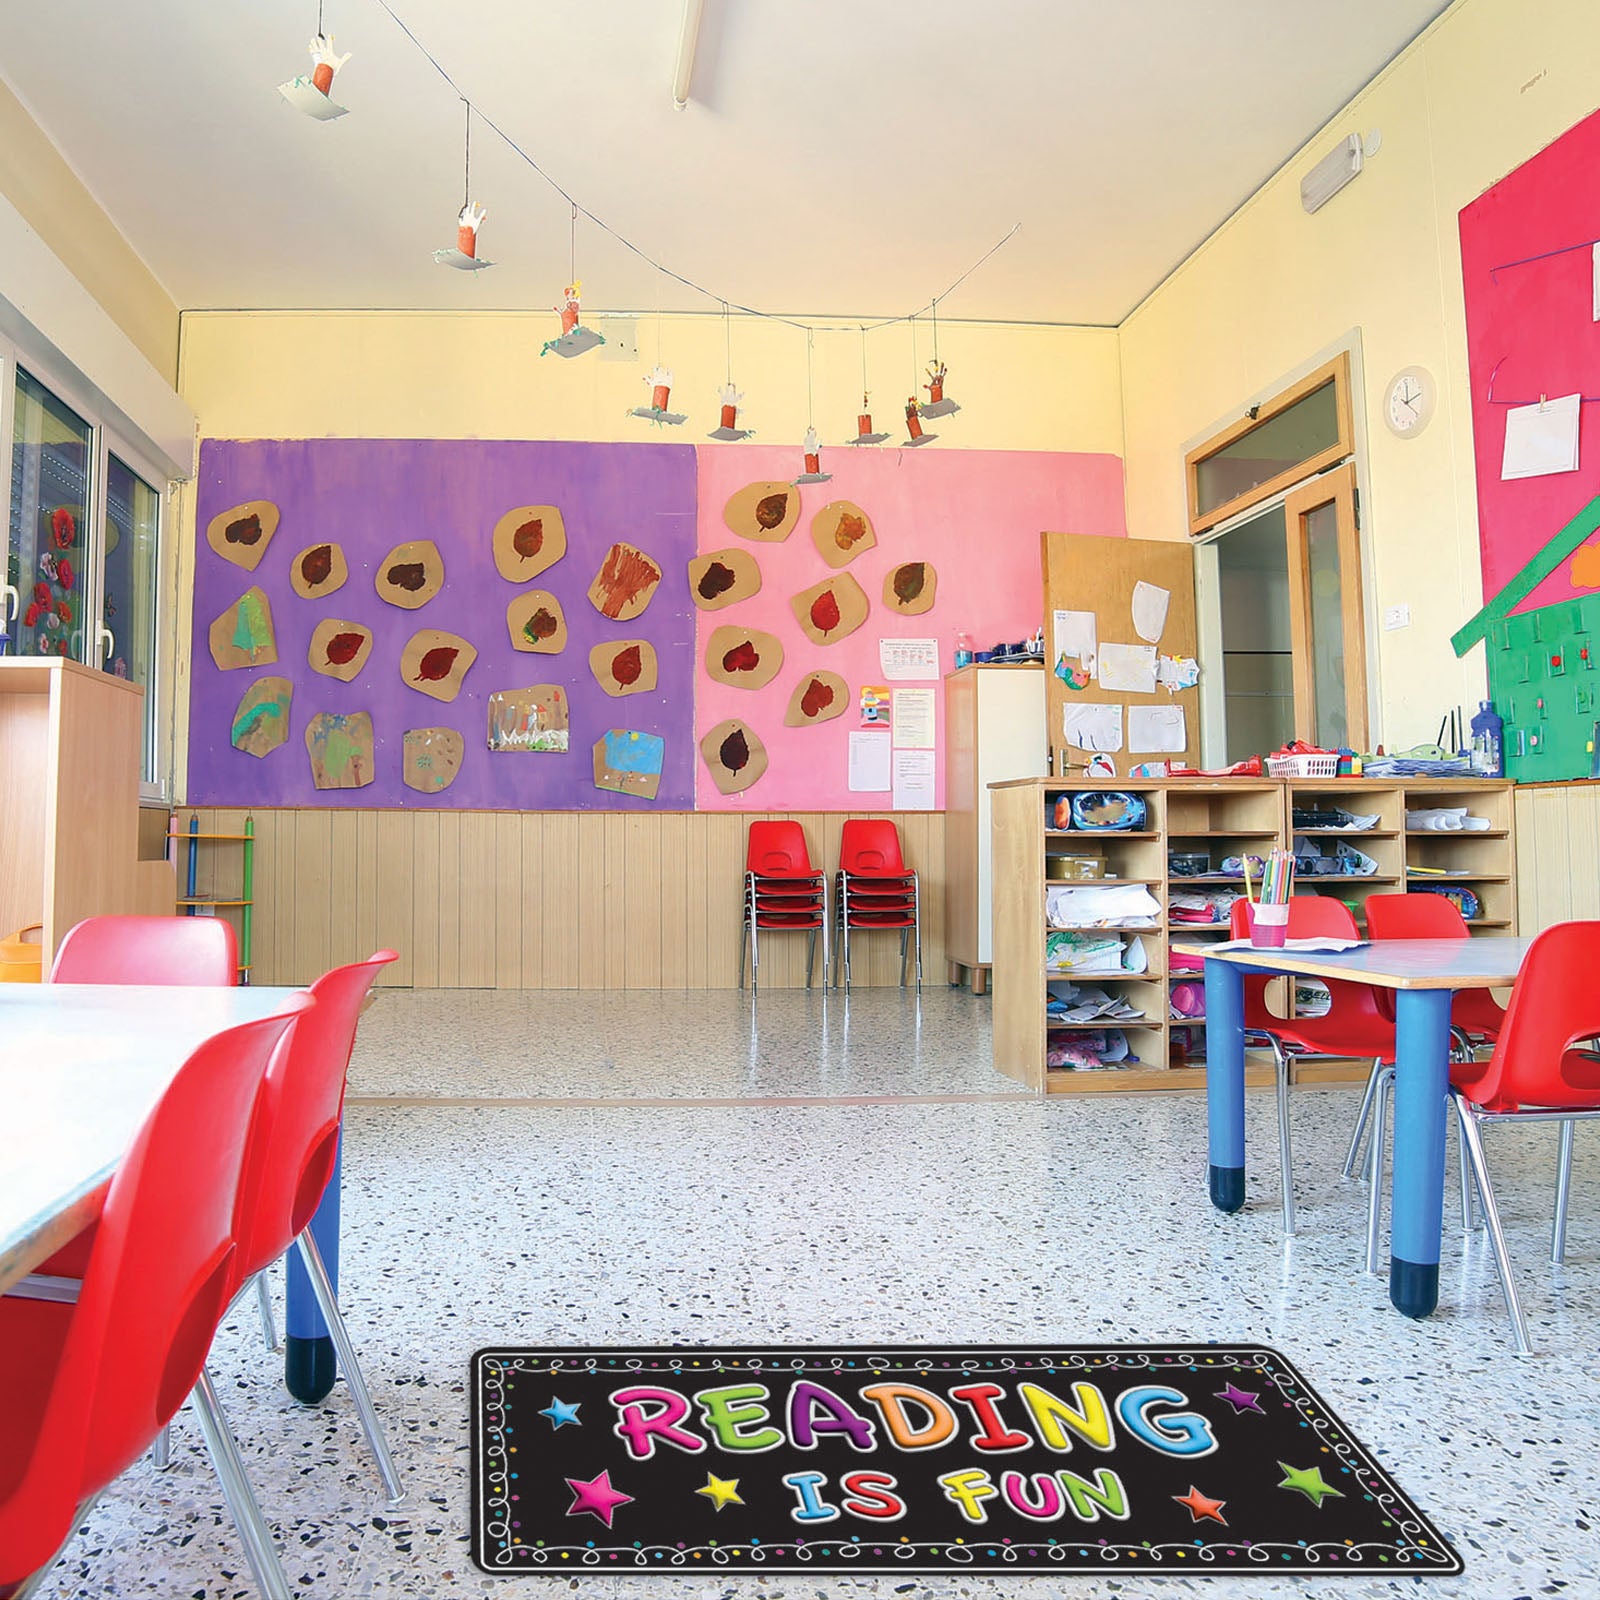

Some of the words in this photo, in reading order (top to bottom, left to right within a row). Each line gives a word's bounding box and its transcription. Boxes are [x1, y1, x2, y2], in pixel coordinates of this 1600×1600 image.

[609, 1380, 1218, 1459] READING
[782, 1468, 907, 1525] IS
[937, 1467, 1131, 1525] FUN
